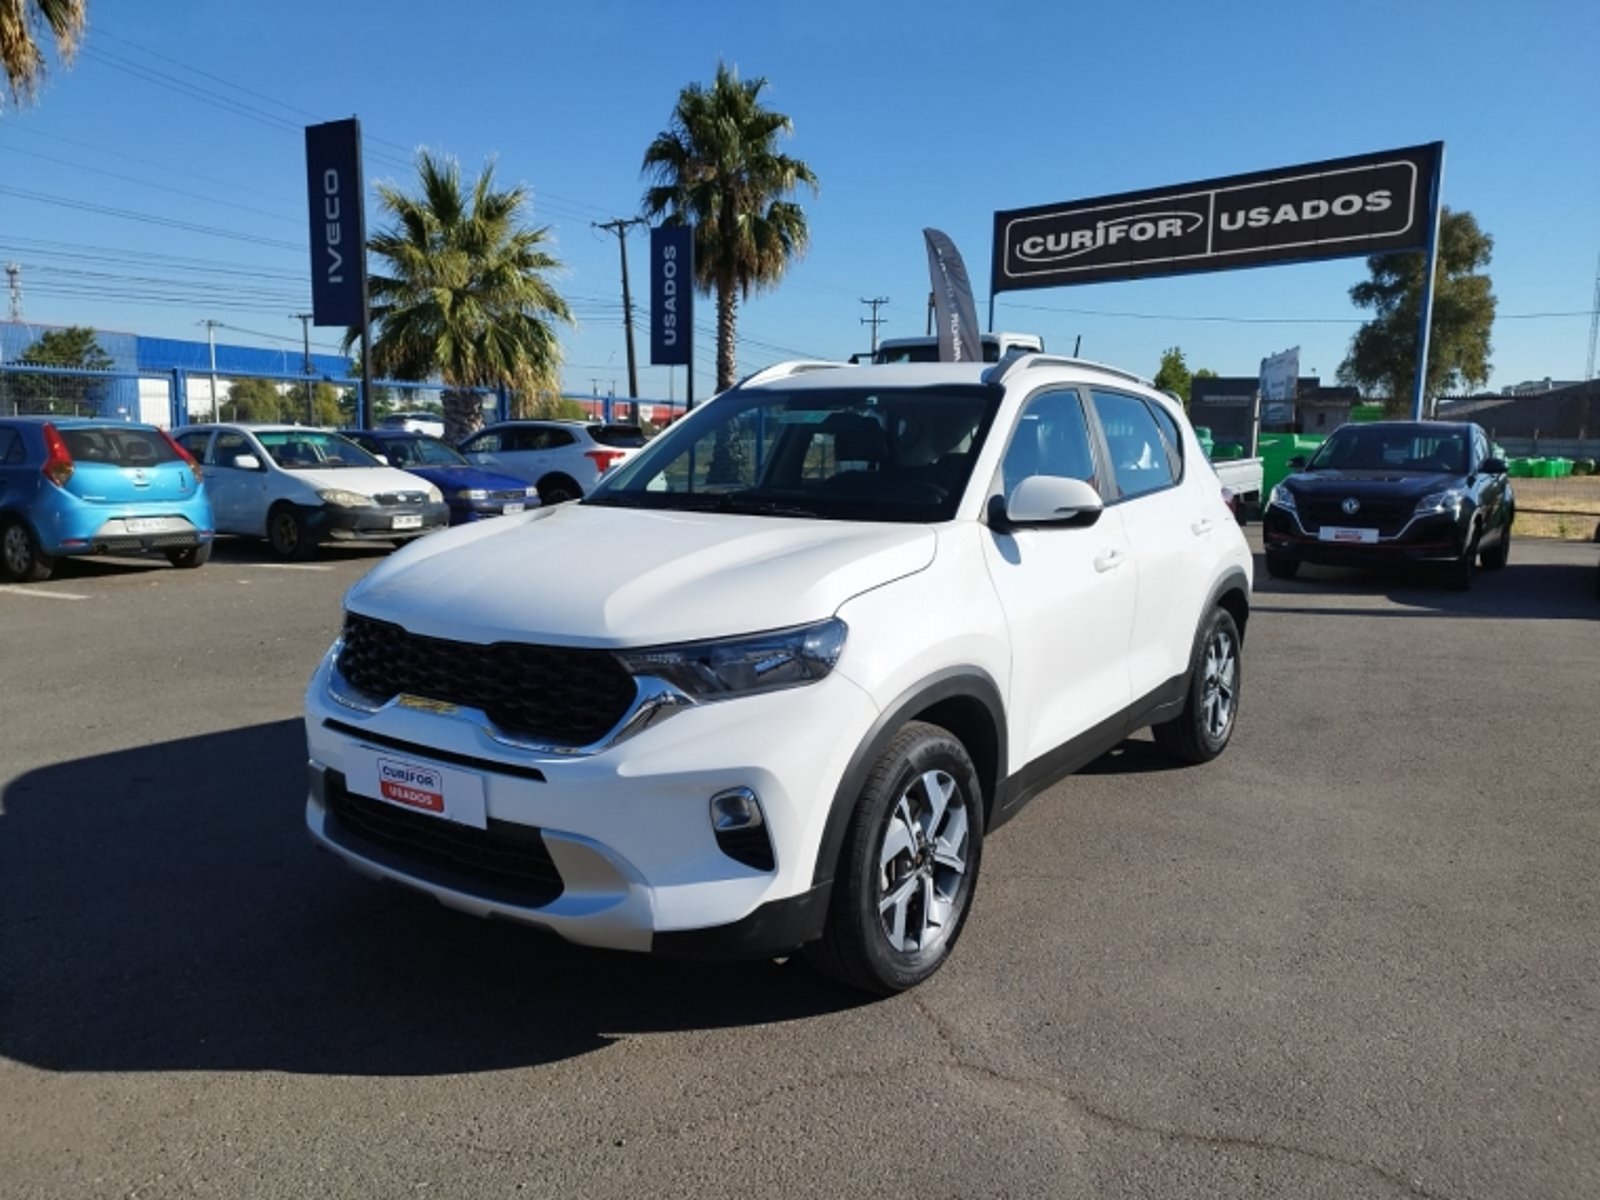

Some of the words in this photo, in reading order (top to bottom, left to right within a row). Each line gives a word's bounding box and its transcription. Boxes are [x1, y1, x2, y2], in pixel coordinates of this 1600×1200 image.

[324, 168, 343, 283] IVECO
[1220, 189, 1392, 231] USADOS
[664, 245, 677, 346] USADOS
[389, 785, 432, 805] USADOS
